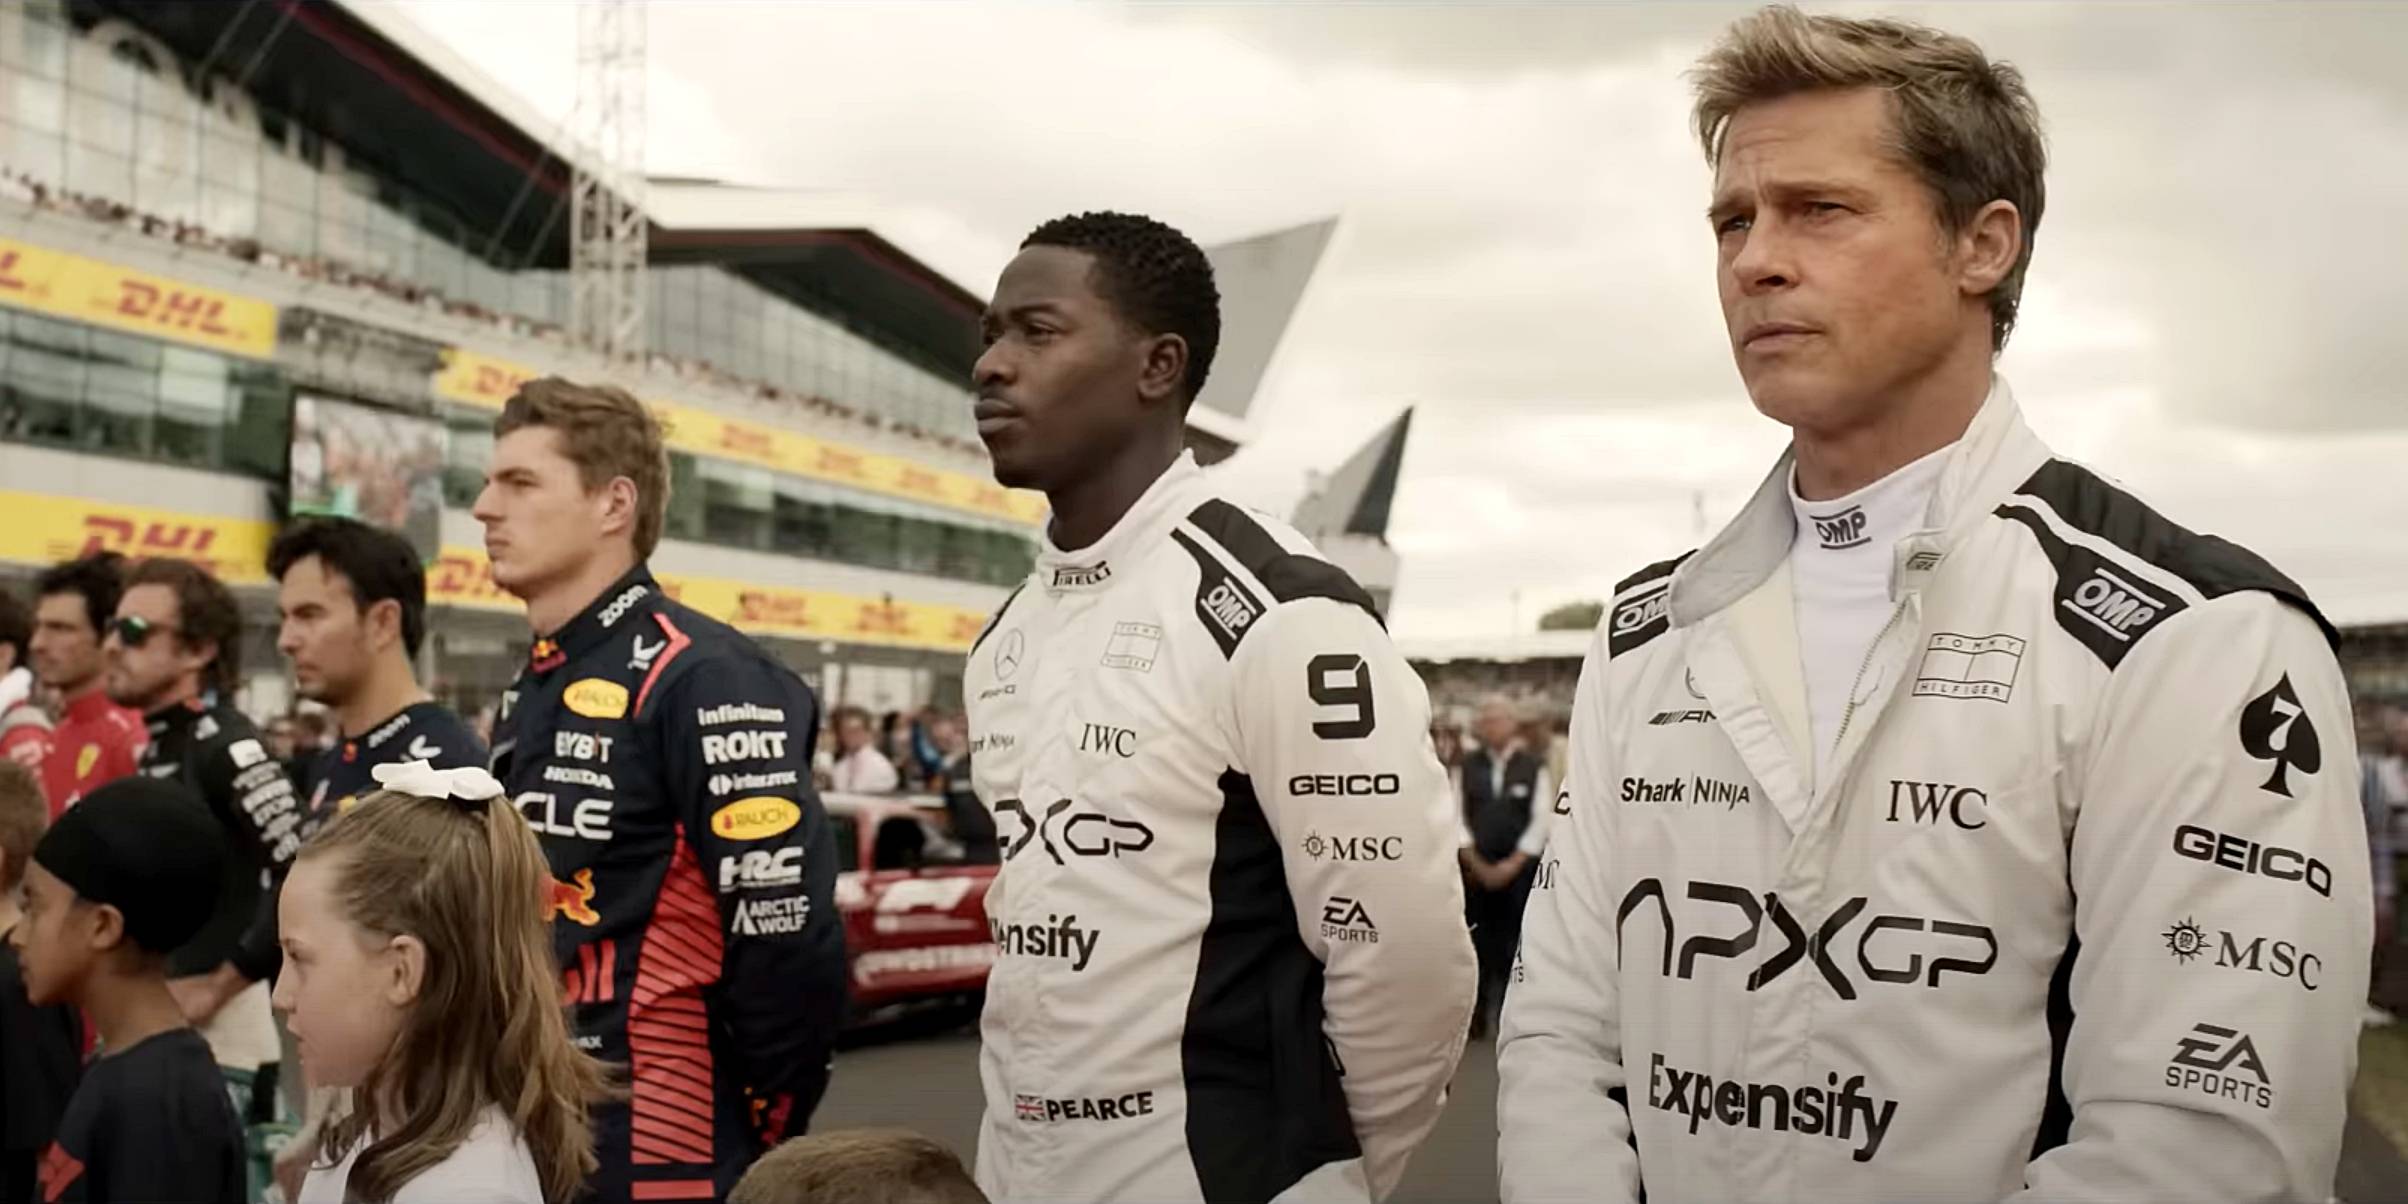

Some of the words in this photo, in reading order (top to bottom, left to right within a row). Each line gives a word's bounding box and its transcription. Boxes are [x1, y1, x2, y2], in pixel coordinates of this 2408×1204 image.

[116, 279, 229, 335] DHL
[1815, 511, 1866, 543] OMP
[597, 584, 649, 628] zoom
[1208, 584, 1251, 629] OMP
[1616, 592, 1669, 629] OM
[2074, 578, 2155, 631] OMP
[1937, 636, 2016, 649] TOMMY
[1307, 654, 1375, 739] 9
[1921, 683, 2000, 696] HILFIGER
[1080, 723, 1136, 758] IWC
[2270, 694, 2303, 751] 7
[702, 730, 788, 765] ROKT
[1289, 774, 1399, 796] GEICO
[1620, 777, 1685, 803] Shark
[1886, 780, 1987, 829] IWC
[513, 791, 614, 840] CLE
[719, 846, 804, 888] HRC
[1330, 836, 1402, 861] MSC
[2173, 824, 2331, 898] GEICO
[750, 895, 811, 917] ARCTIC
[757, 914, 807, 934] WOLF
[1322, 896, 1376, 929] EA
[1321, 923, 1379, 943] SPORTS
[2214, 930, 2322, 991] MSC
[2171, 1023, 2270, 1085] EA
[1046, 1091, 1154, 1122] PEARCE
[2166, 1066, 2272, 1108] SPORTS
[1649, 1052, 1898, 1162] Expensify
